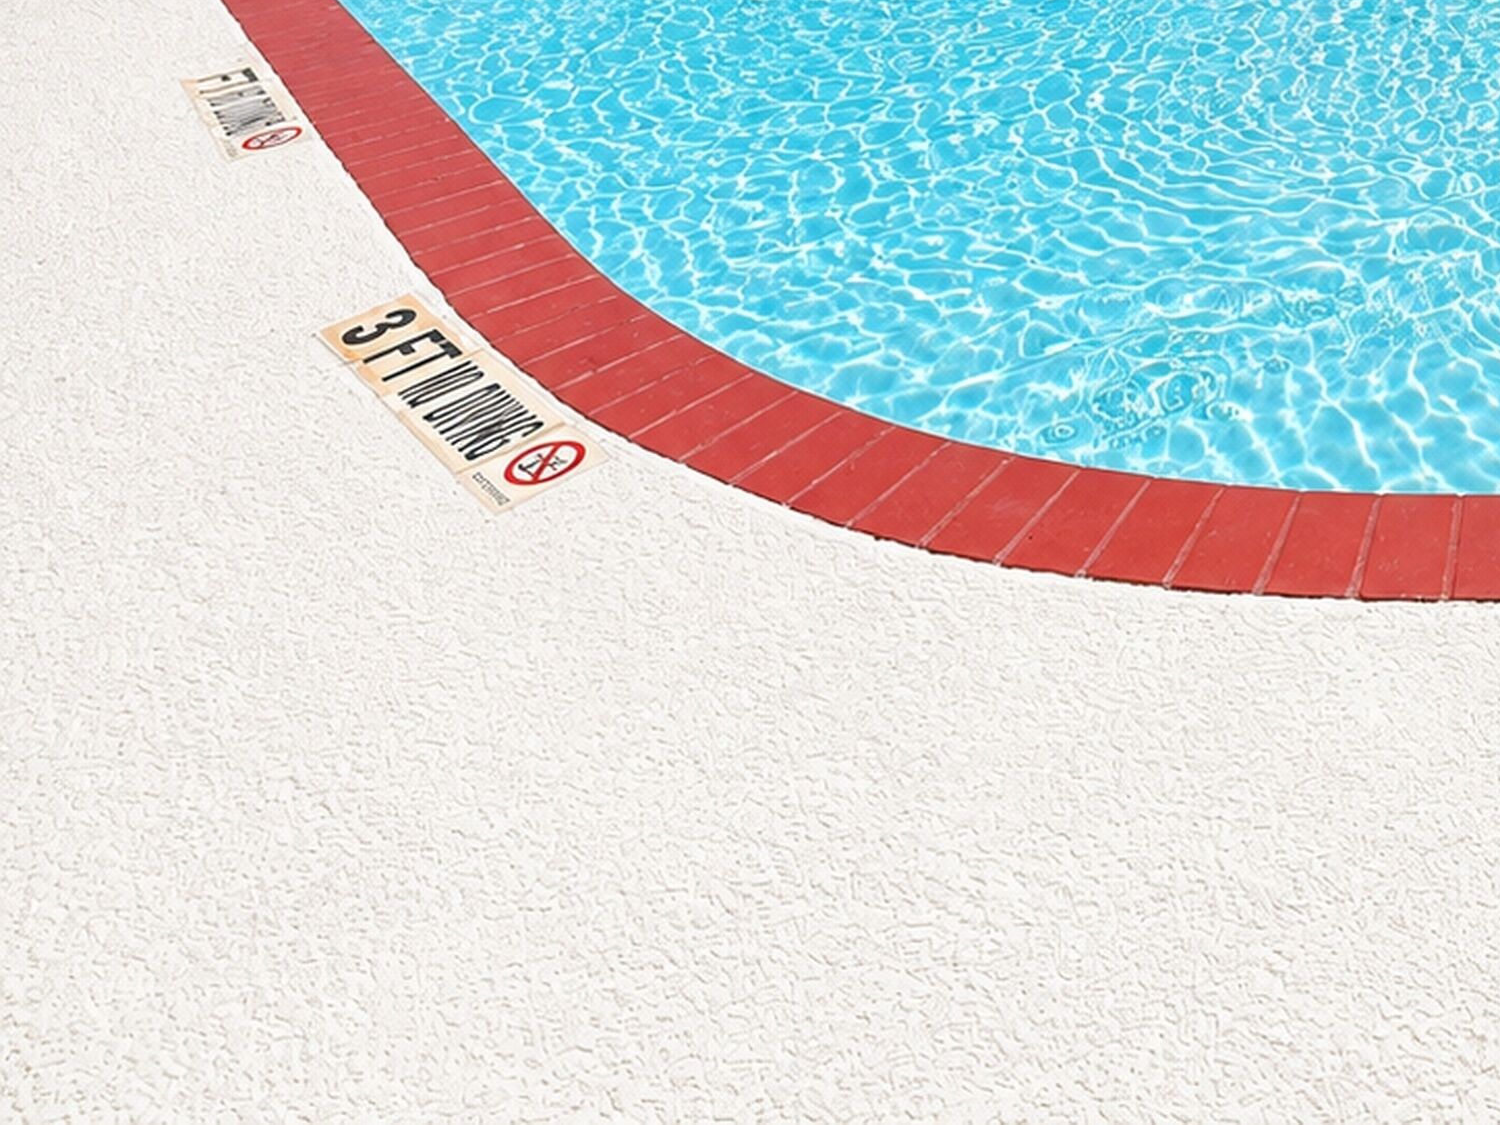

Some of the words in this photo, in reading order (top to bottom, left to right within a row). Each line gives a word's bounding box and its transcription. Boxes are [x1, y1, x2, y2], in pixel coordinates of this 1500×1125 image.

[341, 308, 417, 346] 3
[362, 328, 463, 382] FT
[398, 360, 485, 409] NO
